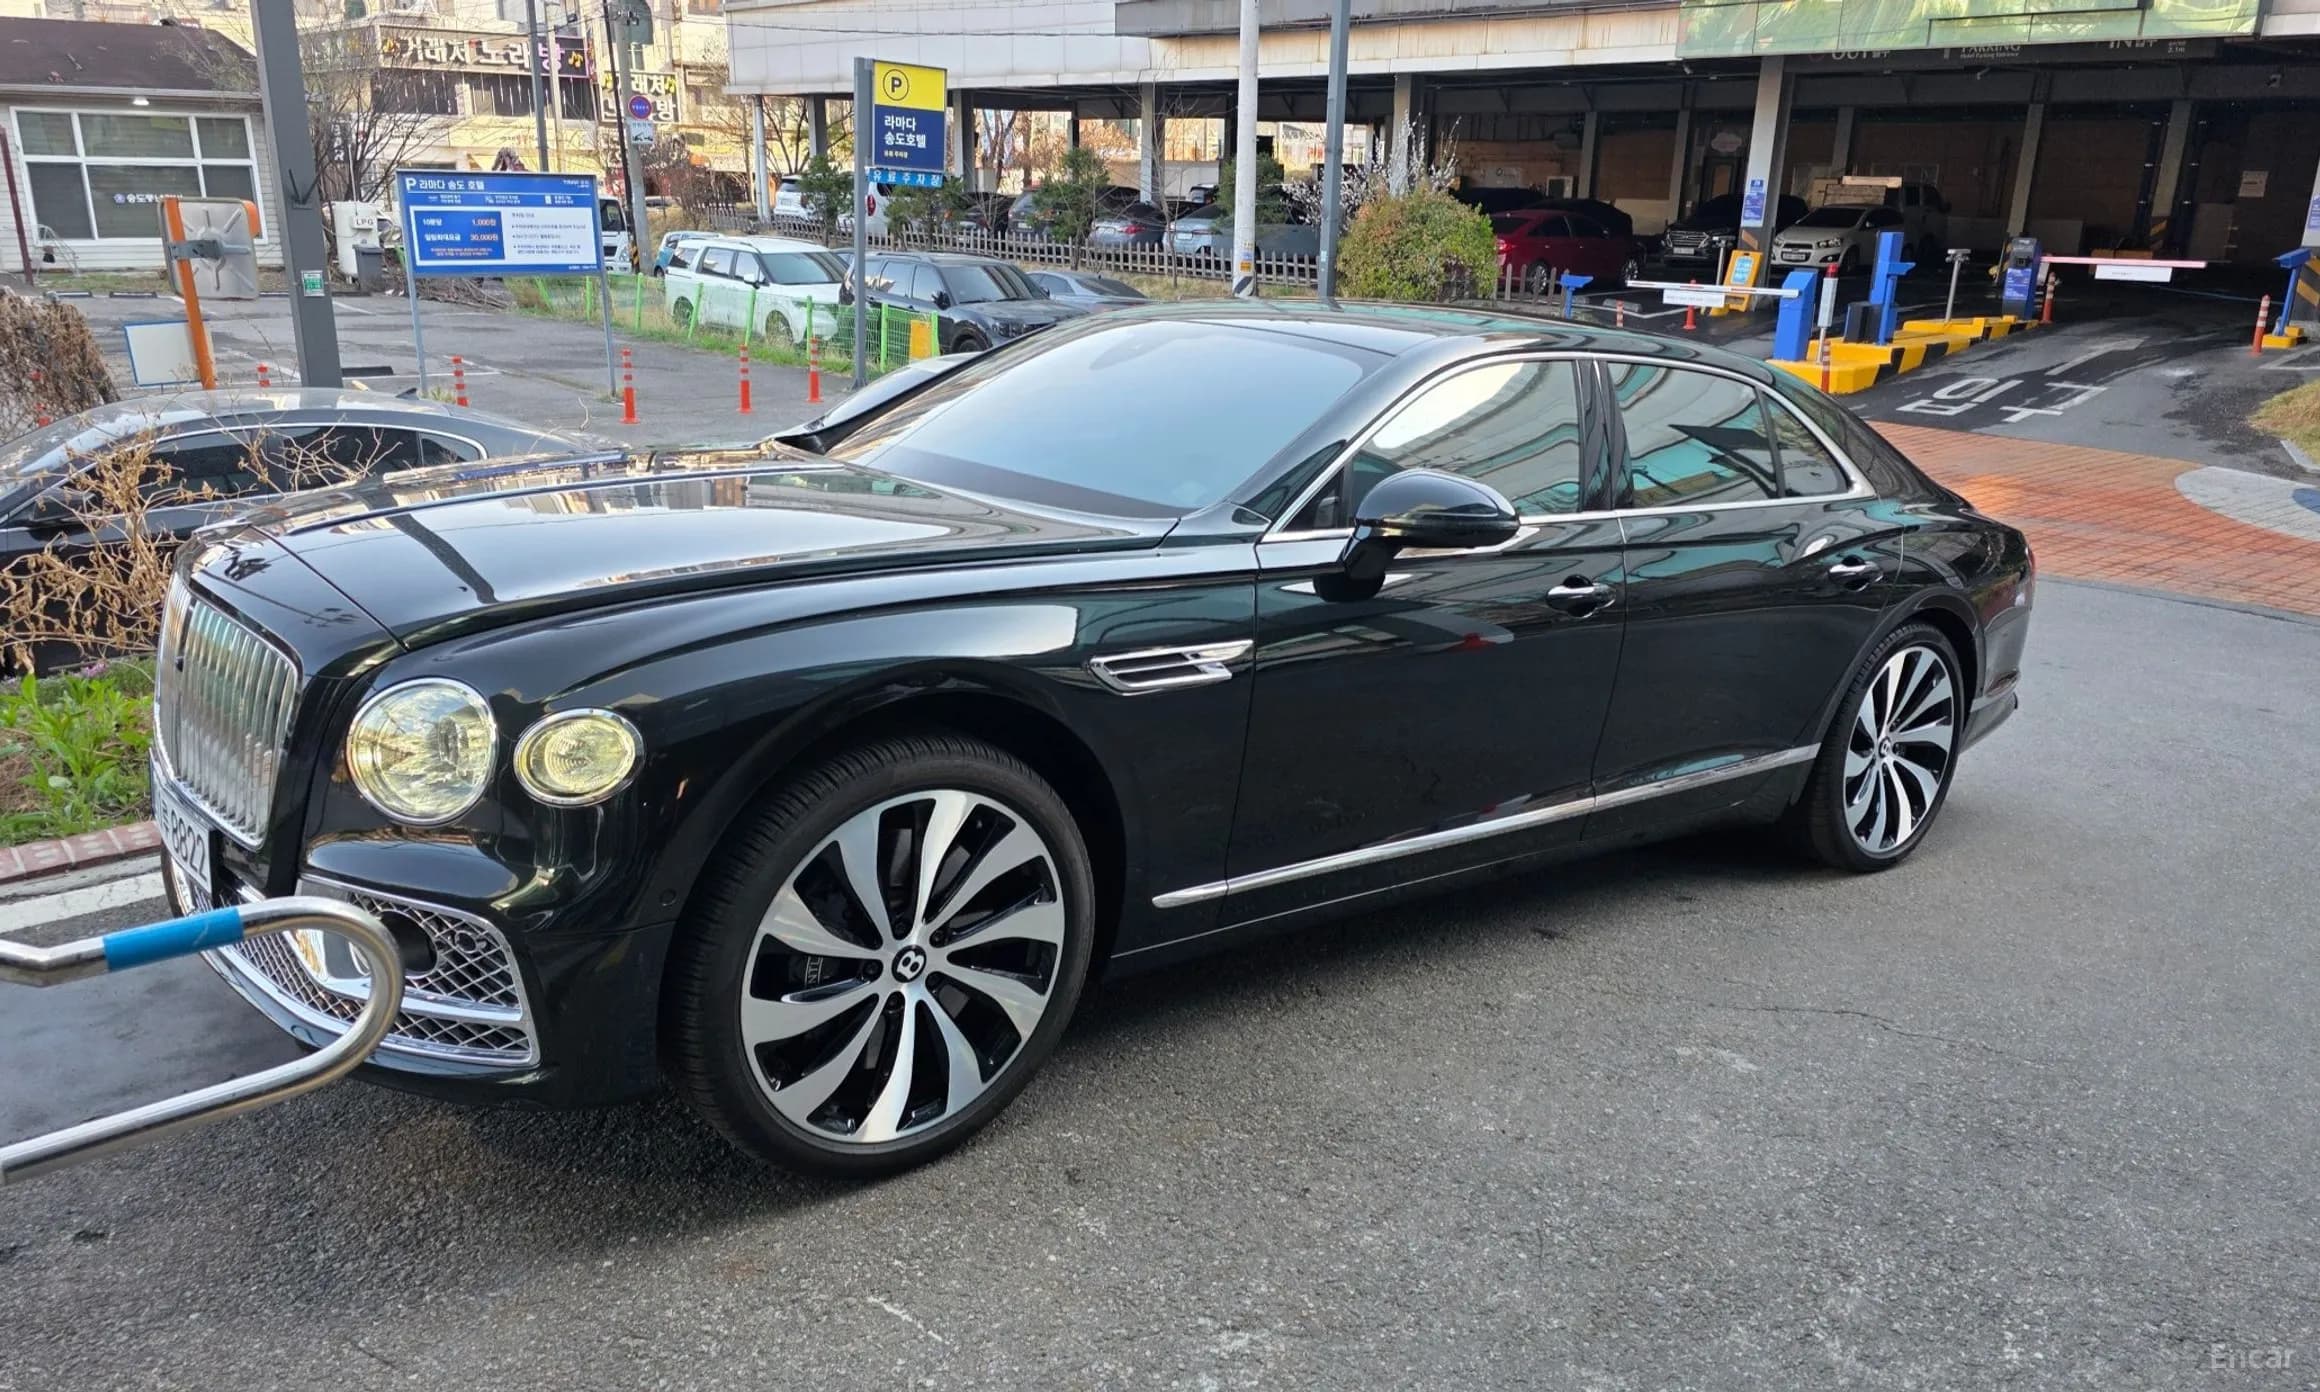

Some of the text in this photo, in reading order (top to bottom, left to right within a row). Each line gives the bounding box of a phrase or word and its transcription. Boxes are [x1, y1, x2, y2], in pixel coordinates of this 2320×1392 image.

[891, 76, 902, 93] P
[884, 115, 917, 132] 라마다
[884, 131, 927, 149] 송도호텔
[405, 177, 485, 191] P 라마다 송도 호텔
[1896, 378, 2108, 423] 입구
